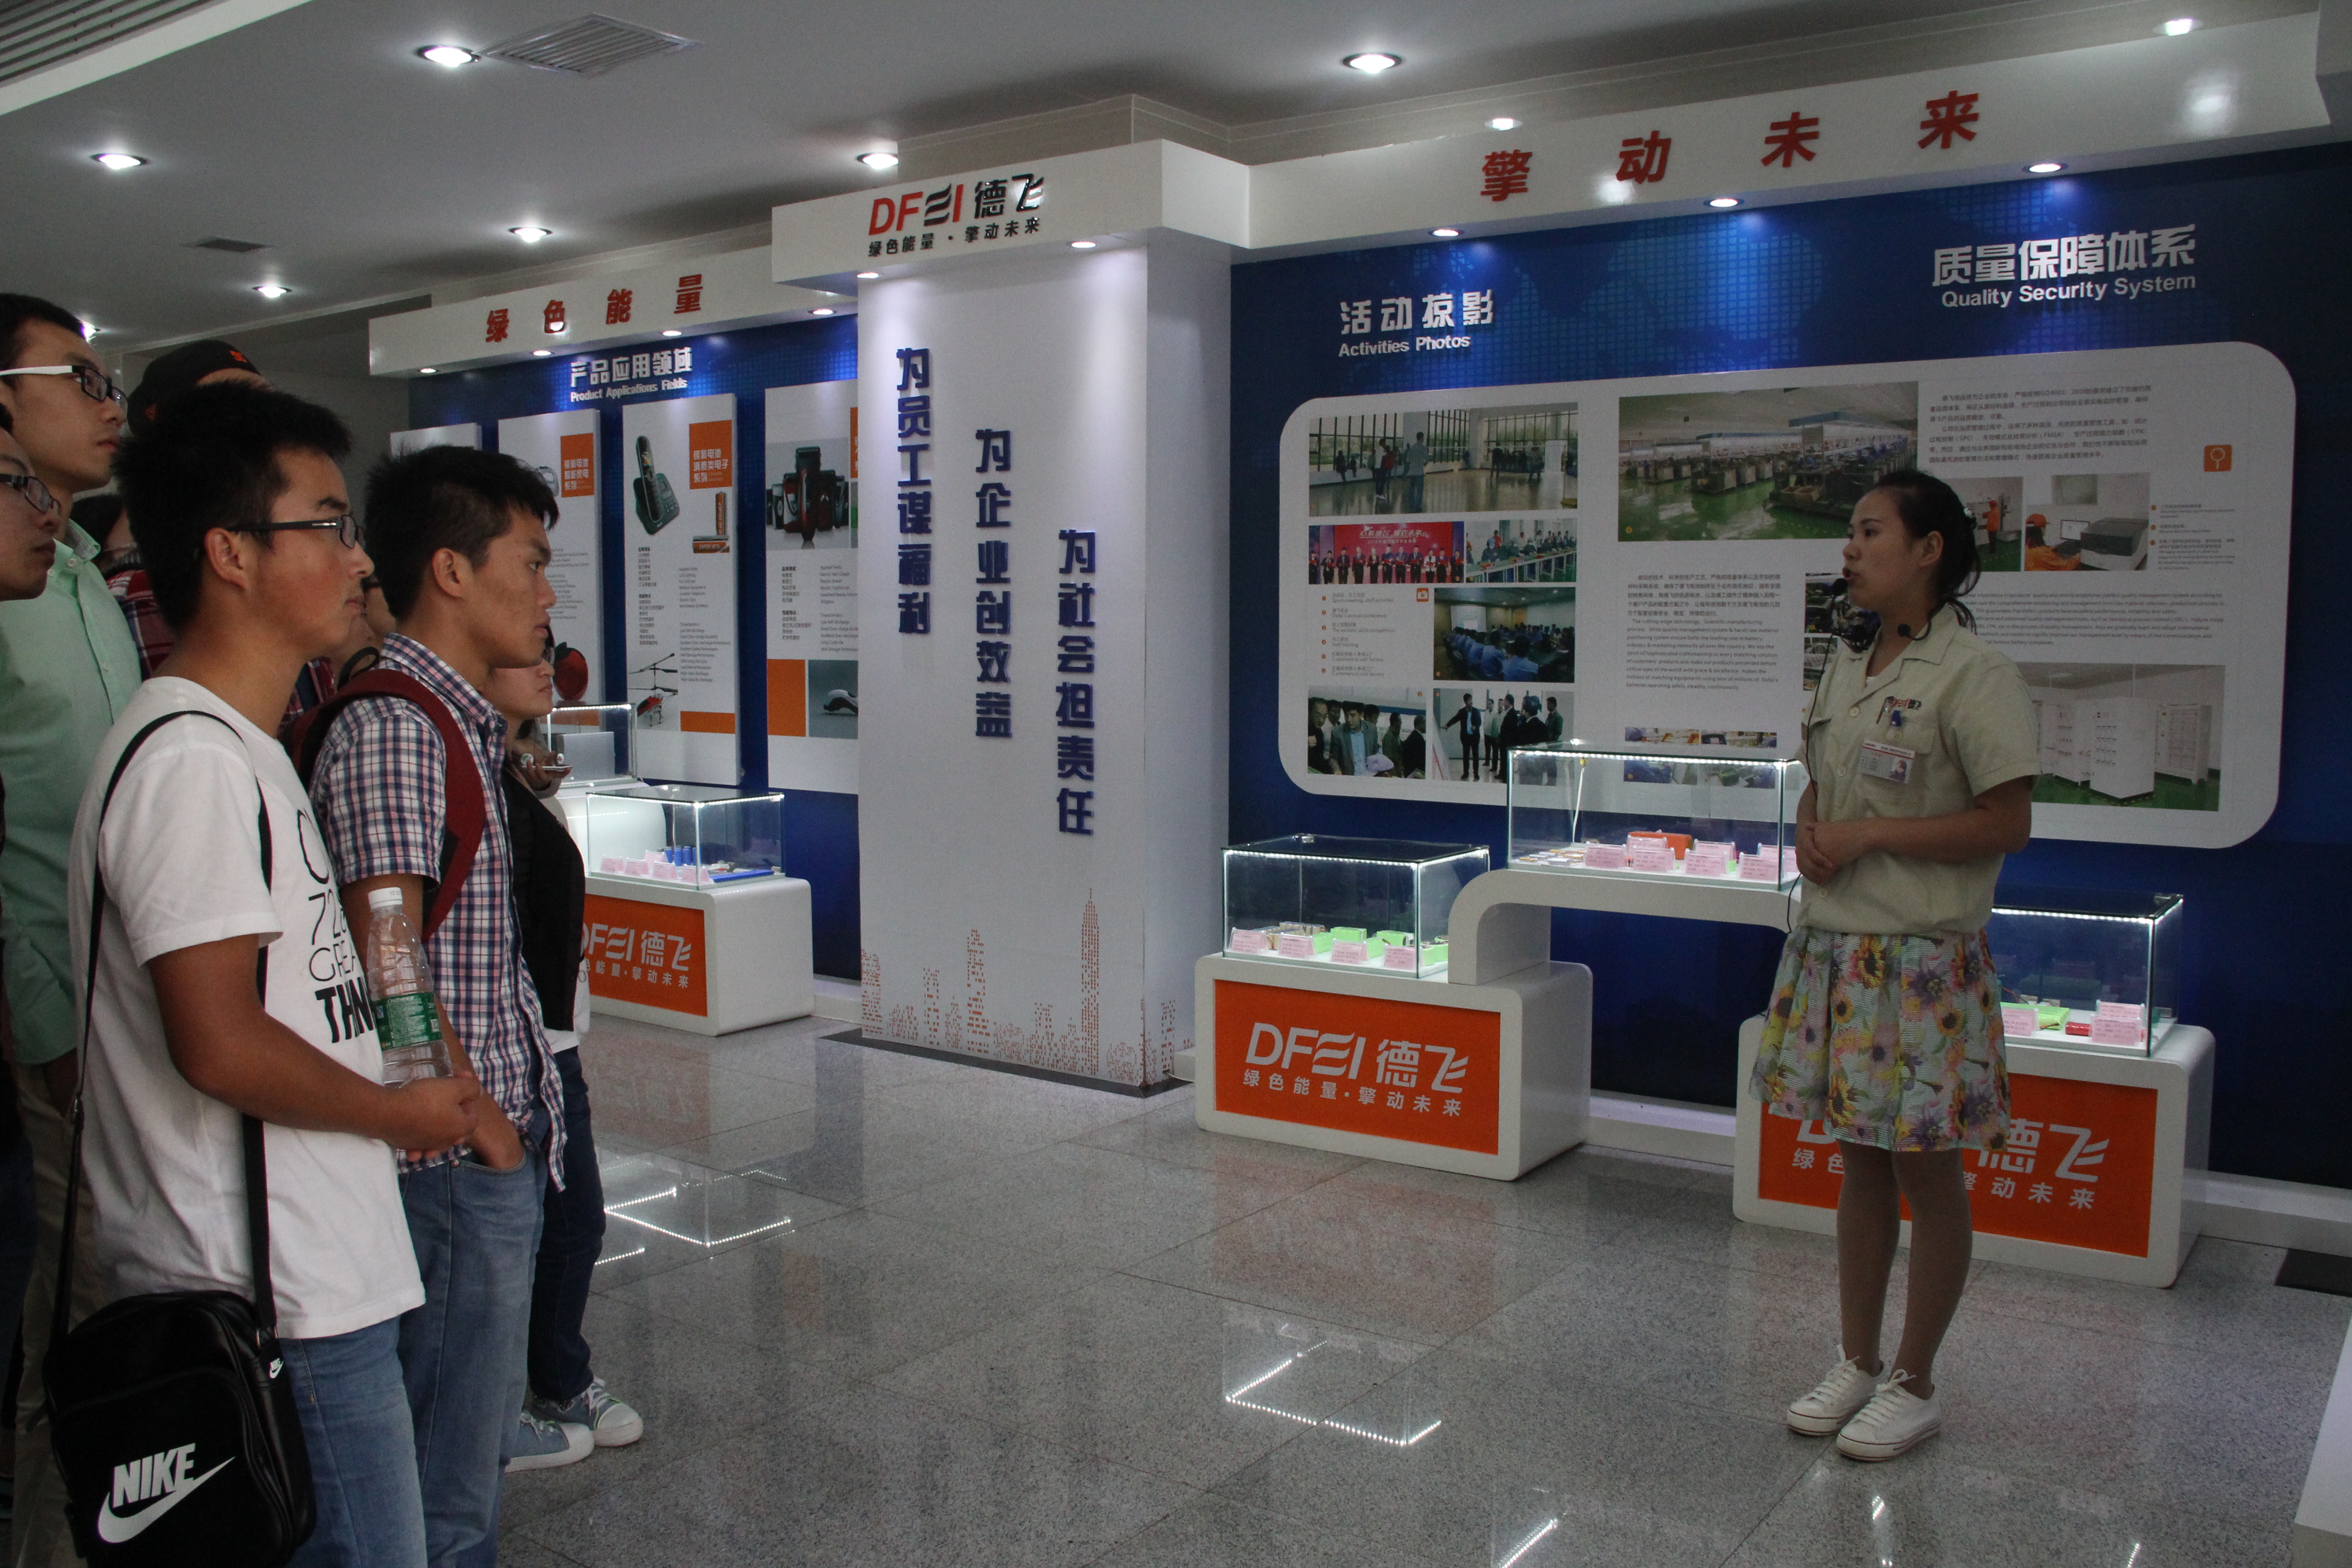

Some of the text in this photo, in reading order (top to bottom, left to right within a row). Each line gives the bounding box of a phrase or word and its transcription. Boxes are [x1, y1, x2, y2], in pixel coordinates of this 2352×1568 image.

[1480, 91, 1980, 201] 擎动未来
[868, 174, 1045, 235] DFEI 德飞
[1932, 225, 2196, 287] 质量保障体系
[485, 274, 703, 343] 绿色能量
[1341, 289, 1494, 335] 活动掠影
[1941, 274, 2196, 309] Quality Security System
[571, 347, 692, 387] 产品应用领域
[1339, 335, 1470, 358] Activities Photos
[571, 377, 688, 402] Product Applications Fields
[897, 348, 931, 634] 为员工谋福利
[975, 429, 1012, 738] 为企业创效益
[1055, 529, 1096, 835] 为社会担责任
[641, 931, 692, 971] 德飞
[1246, 1022, 1469, 1093] DFEI 德飞
[113, 1443, 196, 1509] NIKE
